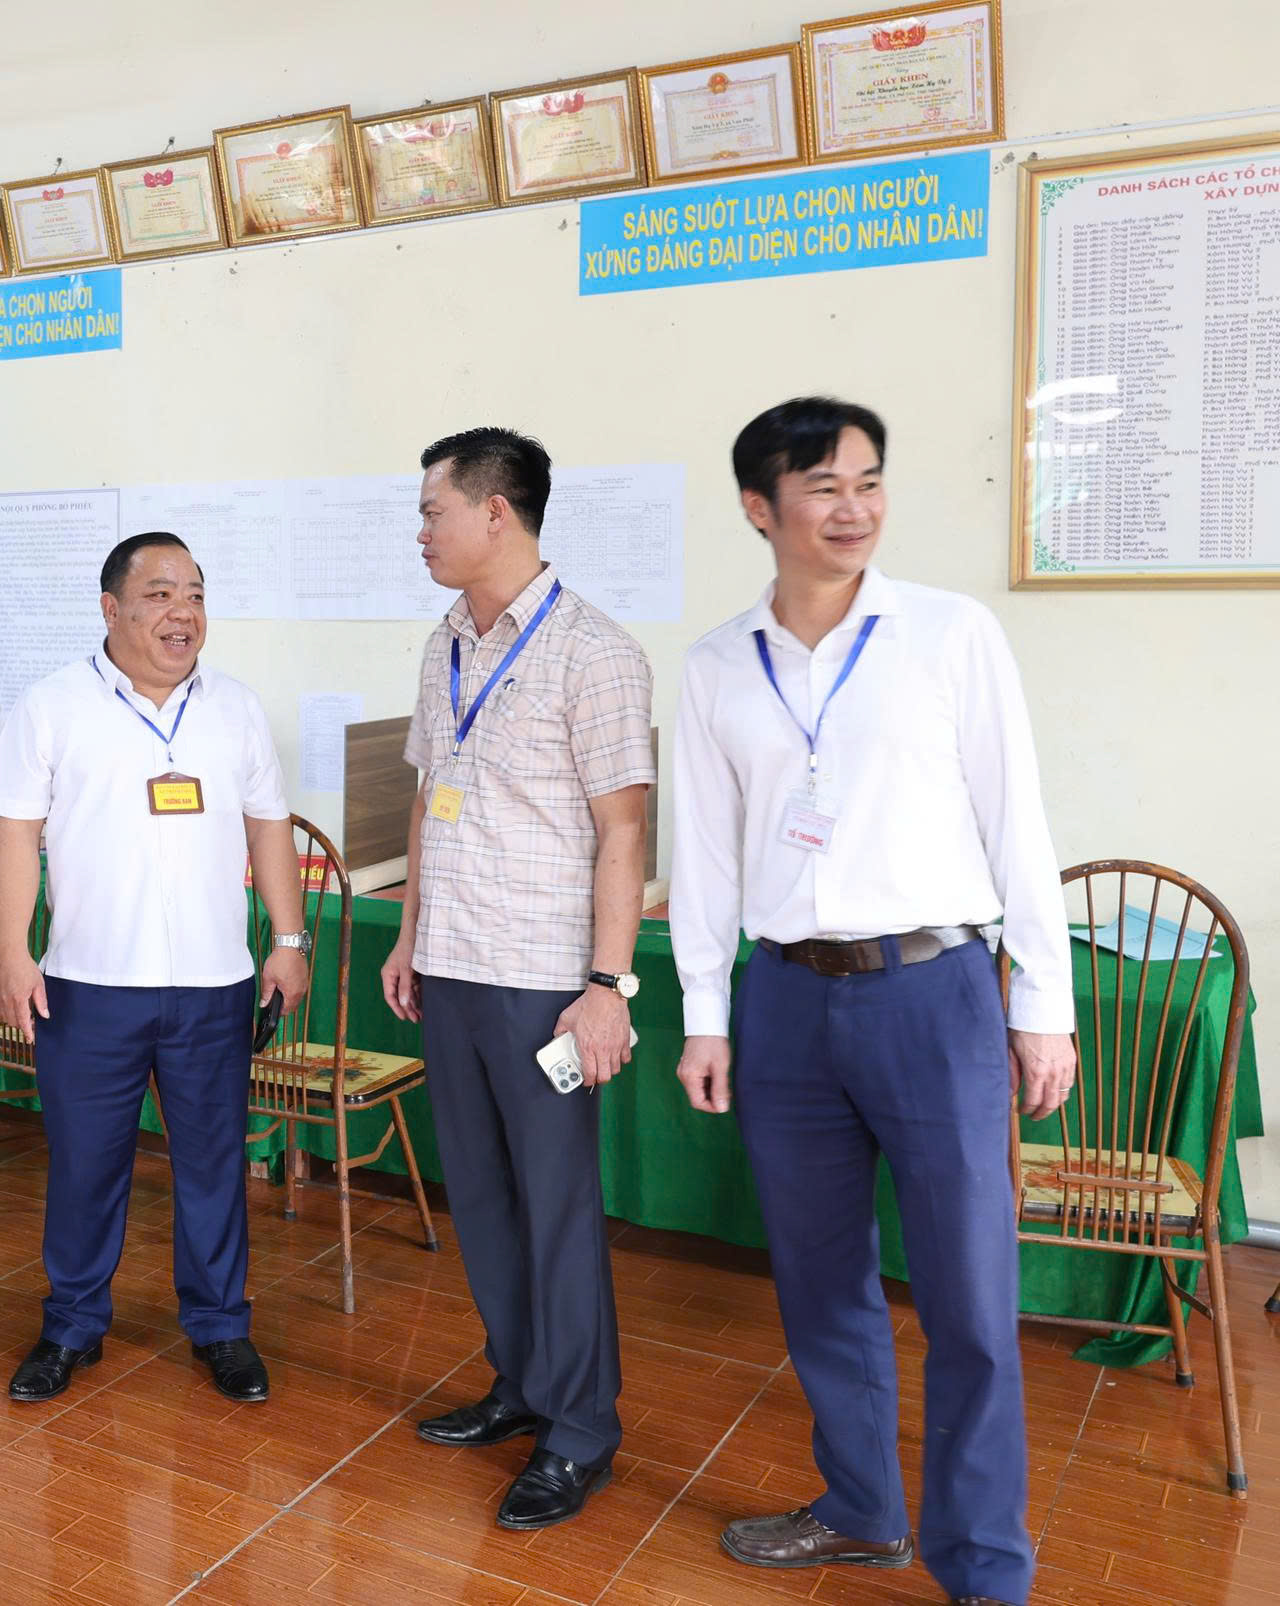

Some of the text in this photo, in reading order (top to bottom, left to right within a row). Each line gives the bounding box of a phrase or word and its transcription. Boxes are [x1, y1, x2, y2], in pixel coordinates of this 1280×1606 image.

[1098, 184, 1142, 197] DANH
[1148, 177, 1190, 191] SÁCH
[1195, 171, 1228, 185] CÁC
[1234, 164, 1256, 180] TỔ
[1203, 186, 1238, 200] XÂY
[624, 168, 939, 240] SÁNG SUỐT LỰA CHỌN NGƯỜI
[585, 204, 984, 280] XỨNG ĐÁNG ĐẠI DIỆN CHO NHÂN DÂN!
[8, 292, 46, 320] CHỌN
[16, 320, 42, 345] CHO
[46, 312, 82, 342] NHÂN
[86, 308, 120, 338] DÂN!
